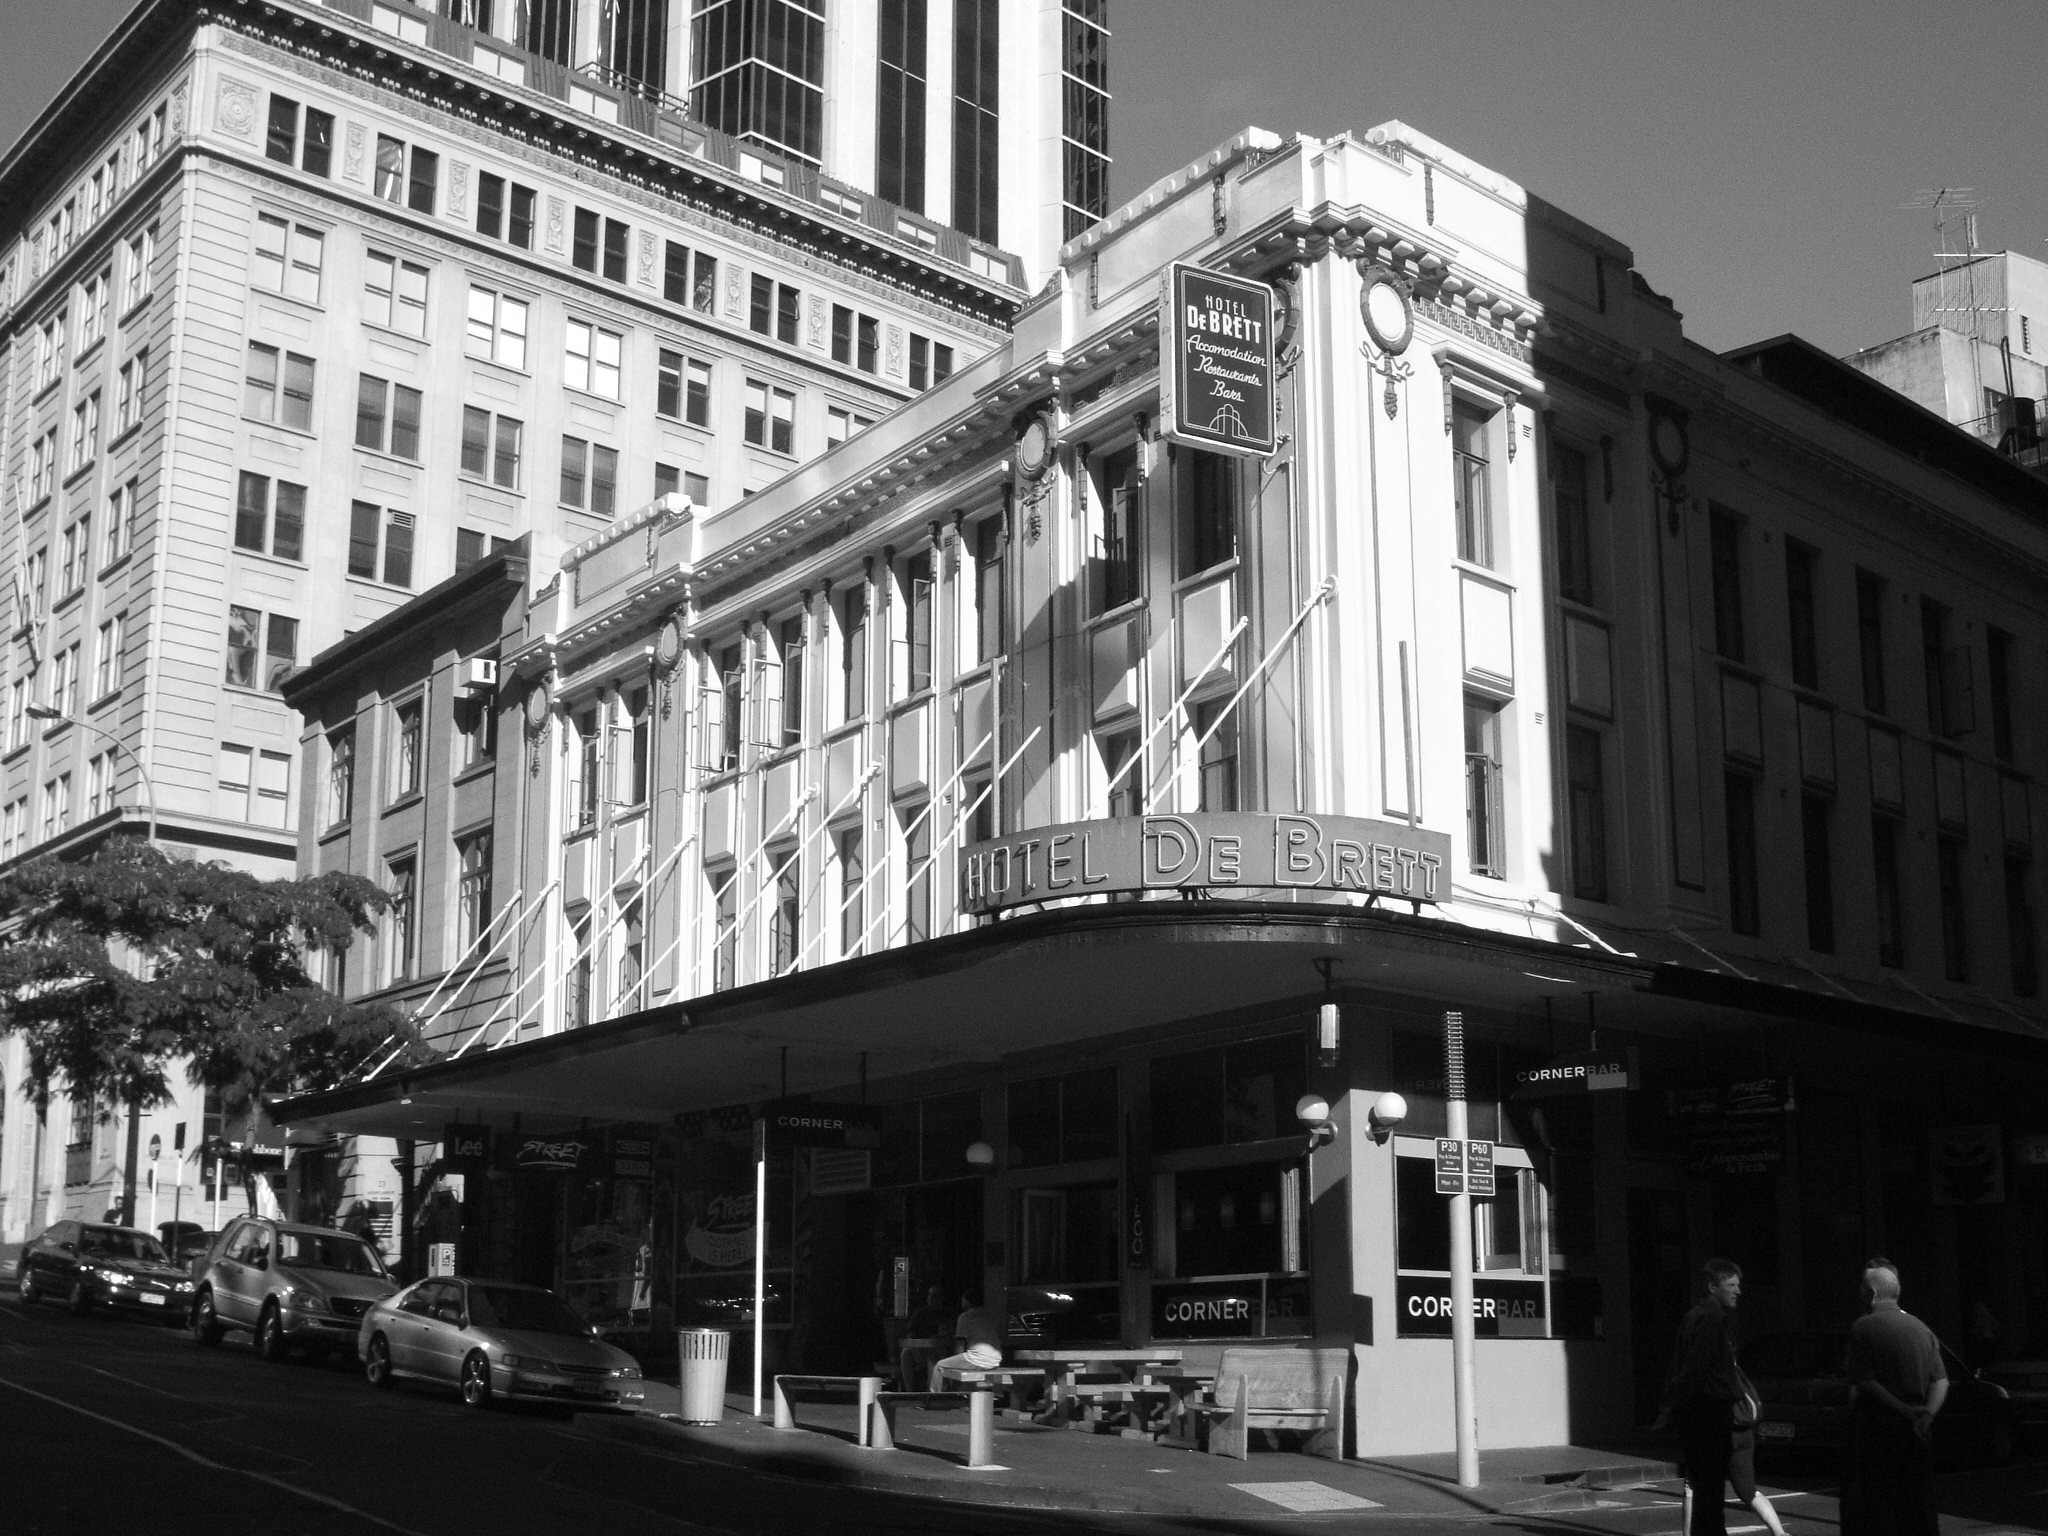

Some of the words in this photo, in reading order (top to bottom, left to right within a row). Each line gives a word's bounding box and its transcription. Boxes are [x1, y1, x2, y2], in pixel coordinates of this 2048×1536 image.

[1205, 295, 1247, 318] HOTEL
[1186, 334, 1267, 367] Accomodation
[1194, 354, 1262, 386] Restaurants
[1209, 379, 1245, 402] Bars
[967, 830, 1109, 901] HOTEL
[453, 1137, 483, 1157] Lee
[515, 1140, 588, 1162] STREET
[1441, 1141, 1458, 1152] P30
[1471, 1143, 1488, 1154] P60
[1408, 1295, 1496, 1319] CORER
